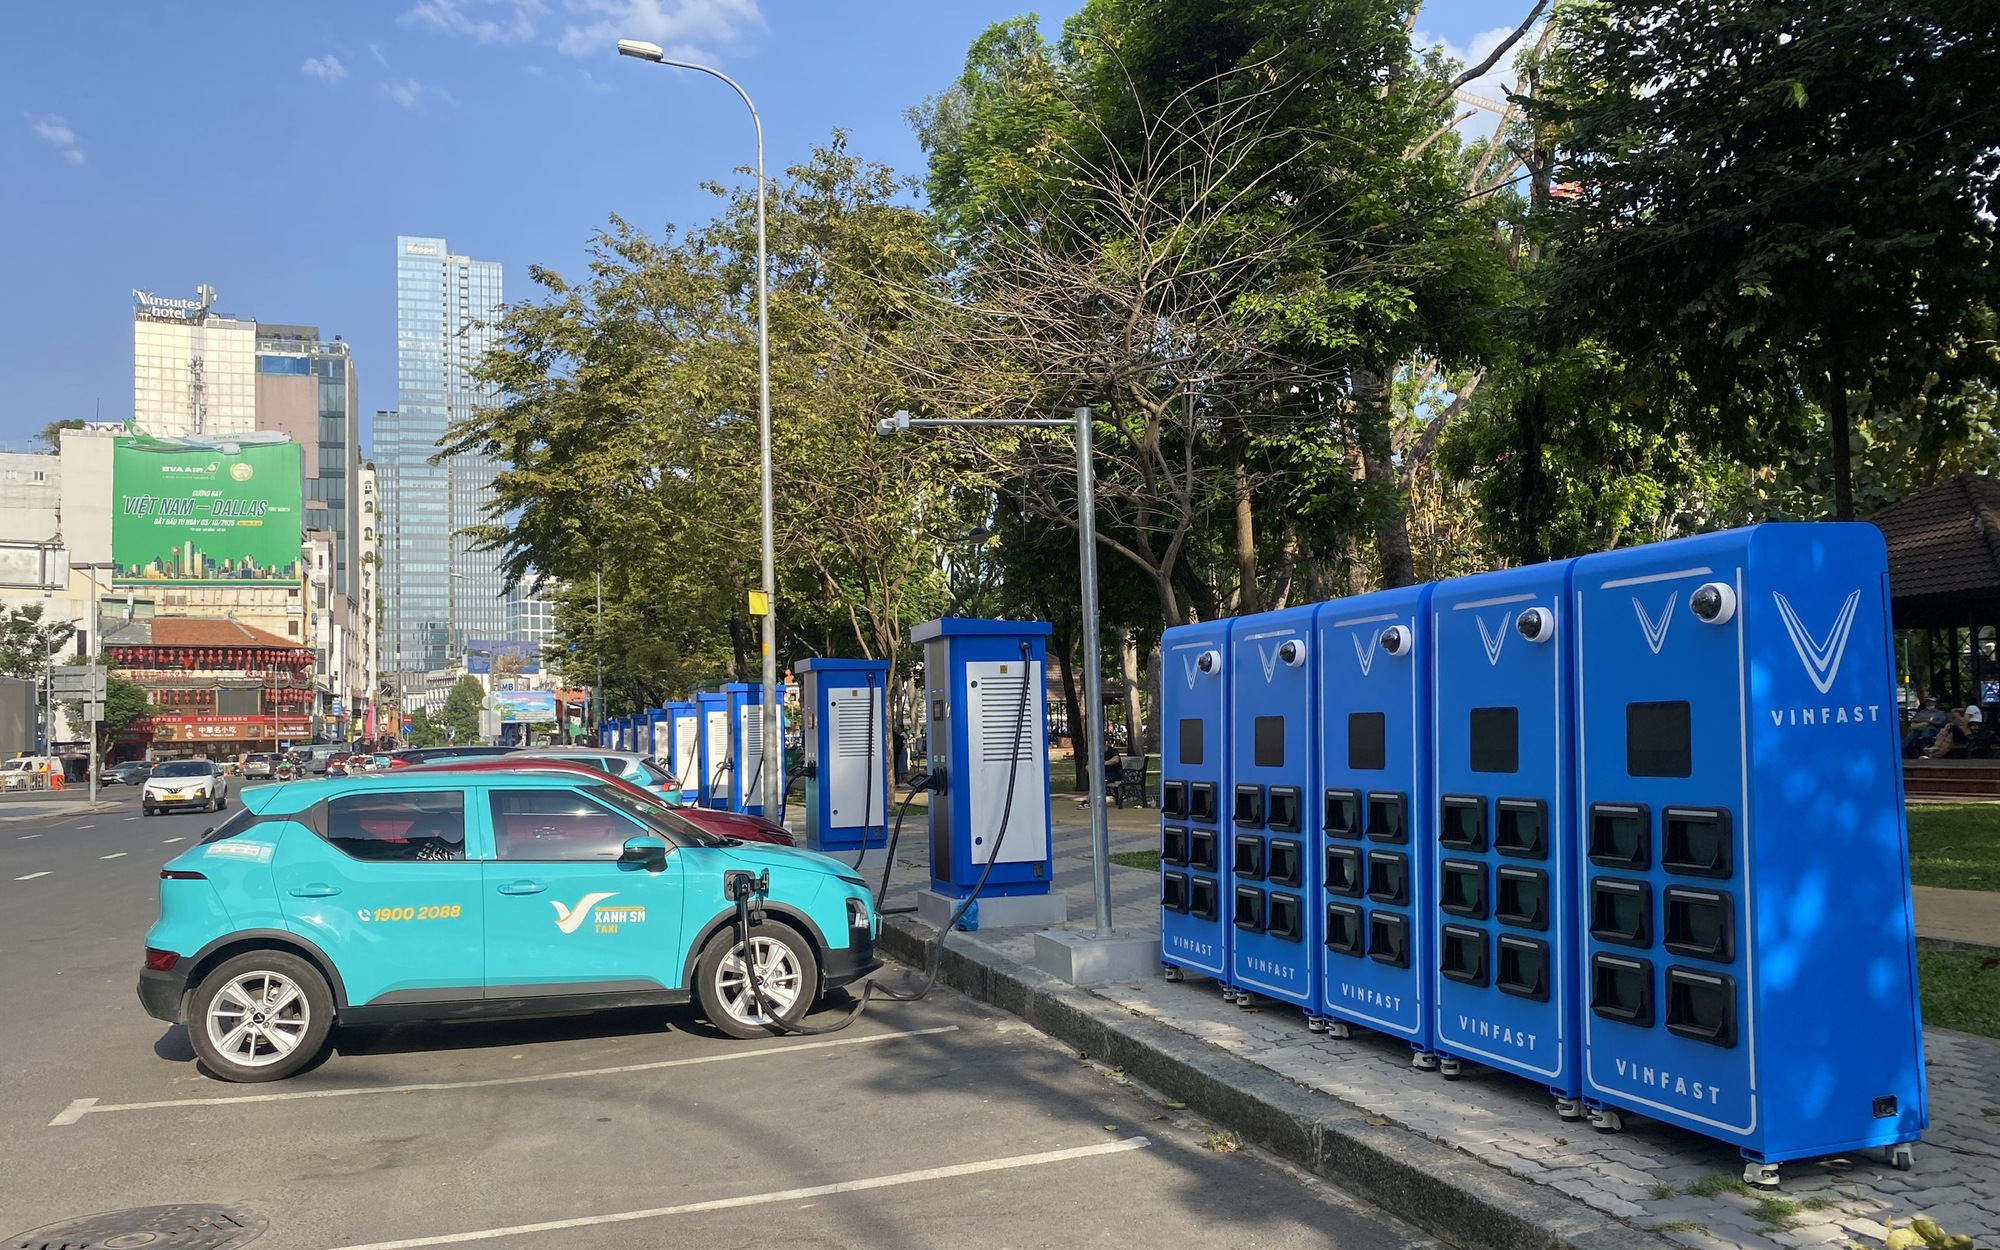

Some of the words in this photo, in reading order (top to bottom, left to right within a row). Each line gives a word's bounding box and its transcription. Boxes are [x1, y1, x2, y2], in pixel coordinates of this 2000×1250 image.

[152, 306, 186, 319] hotel
[124, 494, 159, 518] VIỆT
[158, 498, 196, 516] NAM
[211, 499, 268, 517] DALLAS
[1771, 705, 1879, 727] VINFAST
[374, 906, 415, 922] 1900
[417, 904, 461, 920] 2088
[594, 911, 627, 923] XANH
[629, 911, 646, 923] SM
[594, 924, 619, 934] TAXI
[1173, 935, 1213, 957] VINFAST
[1247, 956, 1295, 980] VINFAST
[1342, 983, 1401, 1011] VINFAST
[1459, 1015, 1537, 1050] VINFAST
[1616, 1058, 1720, 1105] VINFAST
